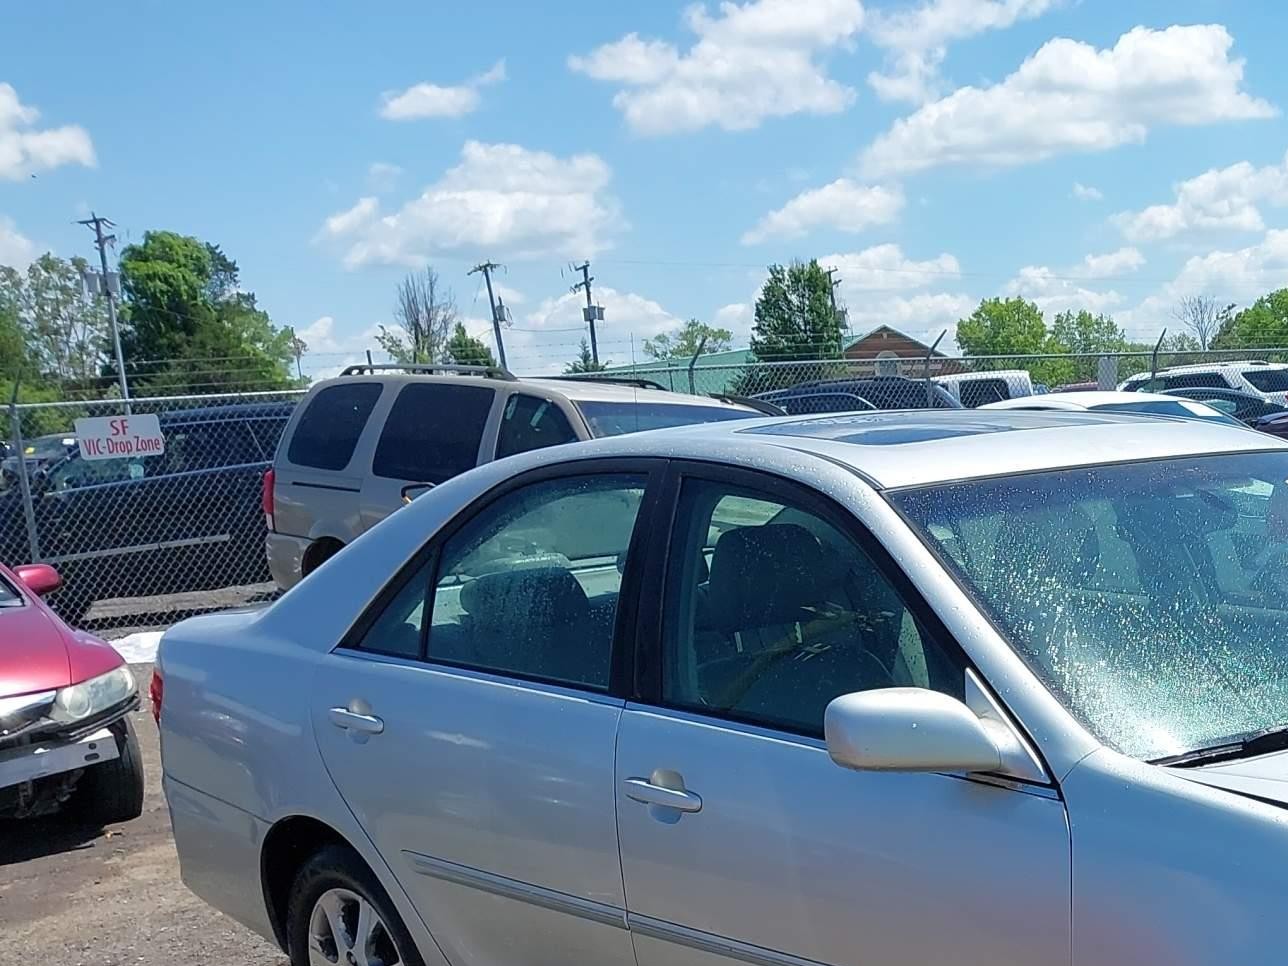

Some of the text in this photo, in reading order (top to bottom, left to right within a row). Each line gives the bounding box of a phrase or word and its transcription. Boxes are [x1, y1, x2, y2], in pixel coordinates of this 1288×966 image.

[110, 419, 129, 436] SF
[83, 436, 161, 456] VIC-Drop Zone
